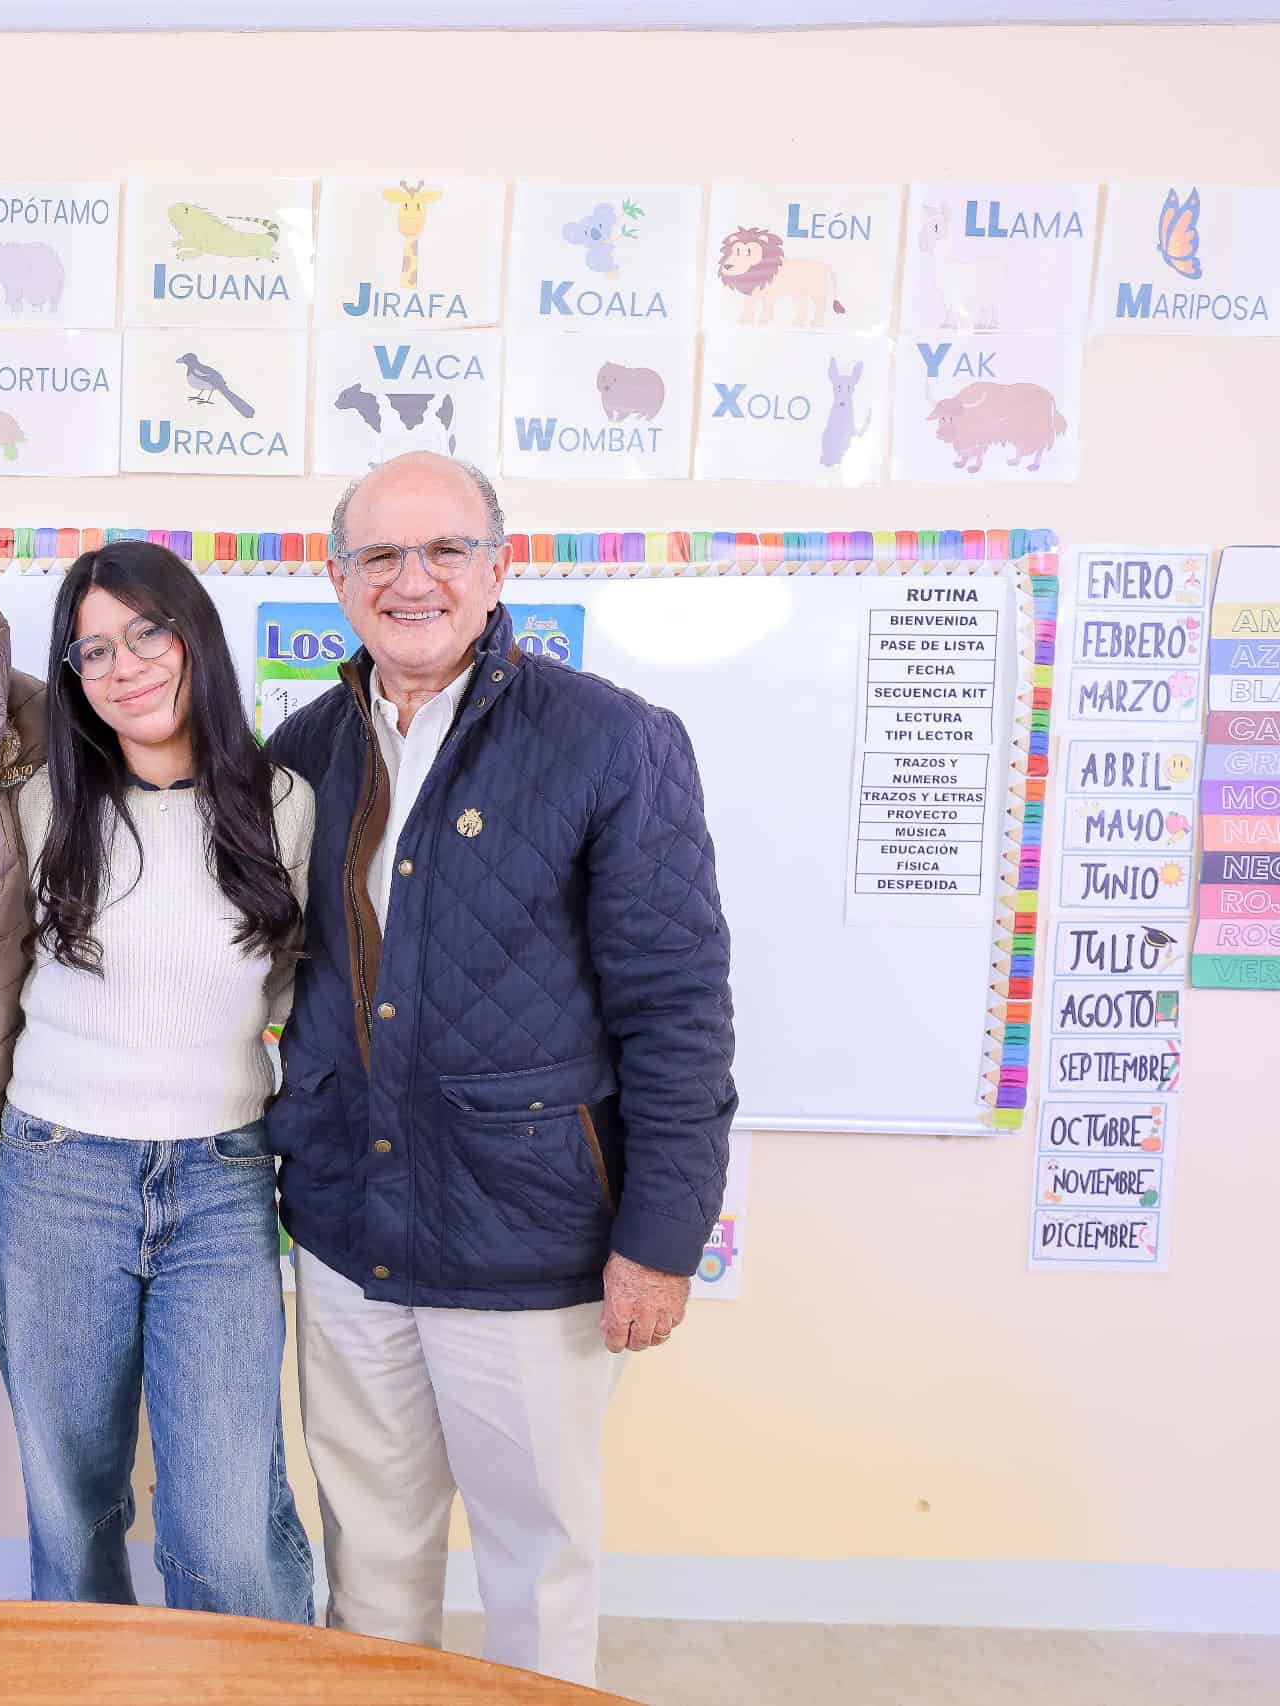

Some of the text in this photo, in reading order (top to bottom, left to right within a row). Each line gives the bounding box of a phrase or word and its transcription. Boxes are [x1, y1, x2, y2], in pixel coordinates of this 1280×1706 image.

[964, 199, 1083, 239] LLAMA
[153, 261, 290, 301] IGUANA
[539, 279, 668, 318] KOALA
[342, 280, 468, 319] JIRAFA
[1115, 282, 1269, 321] MARIPOSA
[372, 344, 485, 380] VACA
[916, 342, 997, 378] YAK
[711, 382, 811, 421] XOLO
[139, 419, 289, 457] URRACA
[514, 415, 664, 454] WOMBAT
[906, 588, 979, 603] RUTINA
[1087, 560, 1174, 600] ENERO
[890, 615, 978, 627] BIENVENIDA
[880, 640, 985, 651] PASE DE LISTA
[1082, 620, 1188, 659] FEBRERO
[907, 664, 956, 676] FECHA
[874, 687, 987, 699] SECUENCIA KIT
[1078, 679, 1172, 715] MARZO
[884, 730, 974, 741] TIPI LECTOR
[896, 712, 963, 723] LECTURA
[894, 757, 959, 768] TRAZOS Y
[1080, 751, 1172, 792] ABRIL
[863, 791, 984, 803] TRAZOS Y LETRAS
[887, 809, 958, 820] PROYECTO
[1085, 807, 1165, 844] MAYO
[877, 879, 958, 890] DESPEDIDA
[1080, 862, 1160, 901] JUNIO
[1070, 930, 1160, 973] JULIO
[1059, 989, 1155, 1029] AGOSTO
[1060, 1052, 1180, 1082] SEPTIEMBRE
[1050, 1114, 1152, 1146] OCTUBRE
[1053, 1168, 1154, 1196] NOVIEMBRE
[1042, 1222, 1147, 1249] DICIEMBRE
